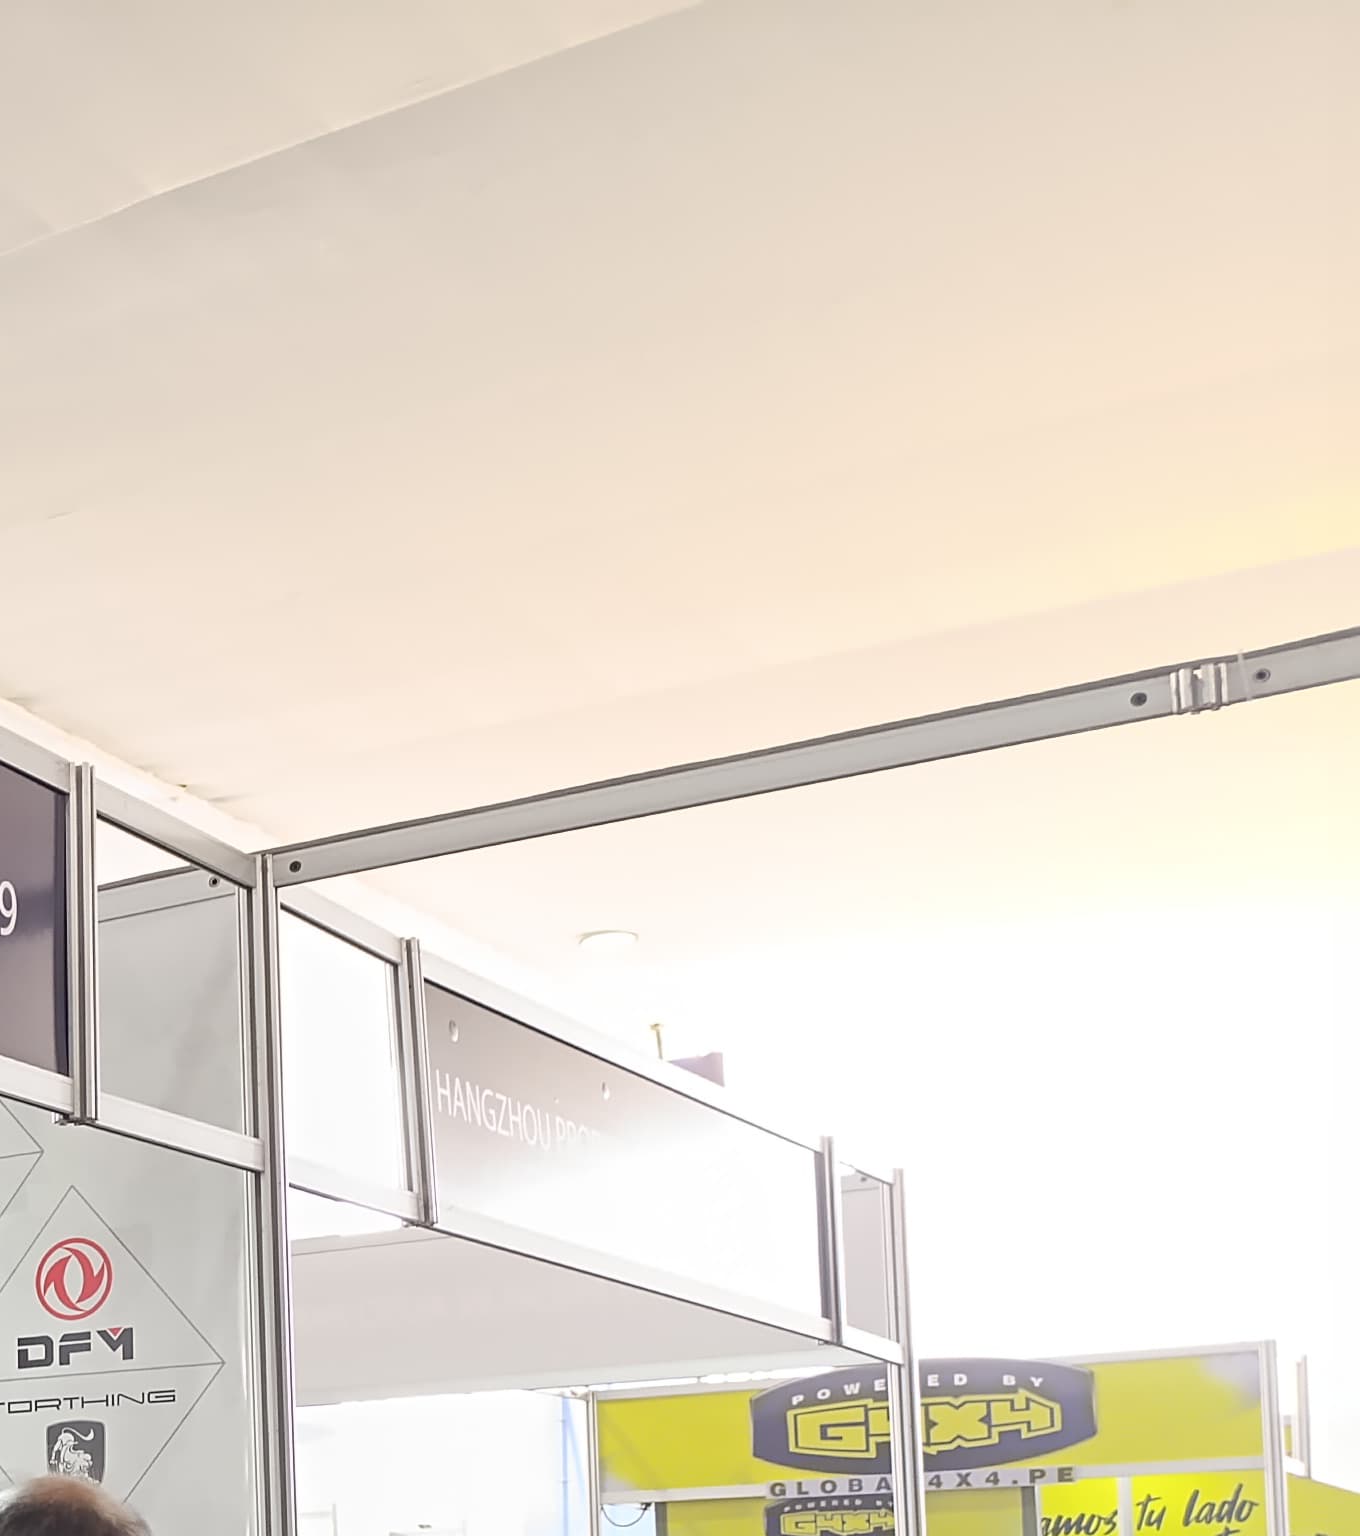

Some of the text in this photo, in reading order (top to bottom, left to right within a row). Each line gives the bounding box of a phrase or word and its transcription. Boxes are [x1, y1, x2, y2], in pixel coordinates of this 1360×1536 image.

[435, 1070, 551, 1151] HANGZHOU
[17, 1327, 134, 1369] DFM
[791, 1373, 1046, 1406] POWEED BY
[769, 1466, 1076, 1498] GLOBA4X4.PE
[1136, 1493, 1168, 1531] tu
[1183, 1483, 1259, 1527] lado
